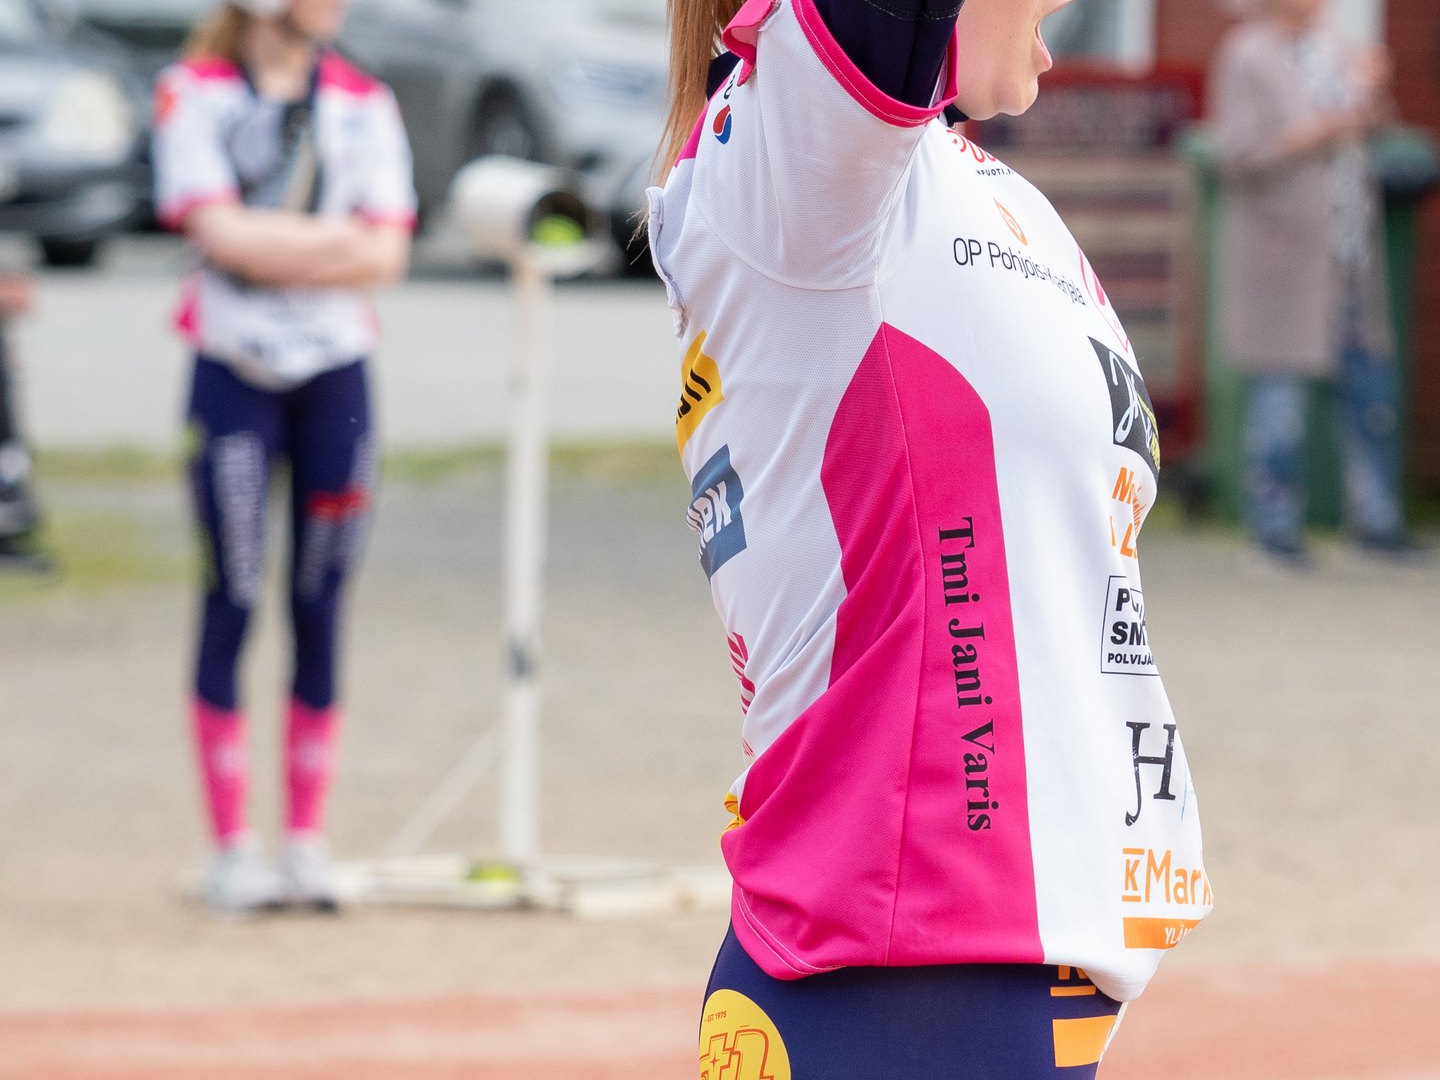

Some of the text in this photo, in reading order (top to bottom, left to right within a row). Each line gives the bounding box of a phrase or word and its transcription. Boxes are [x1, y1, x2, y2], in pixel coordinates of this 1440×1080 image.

[953, 237, 982, 267] OP
[937, 516, 999, 832] Tmi Jani Varis
